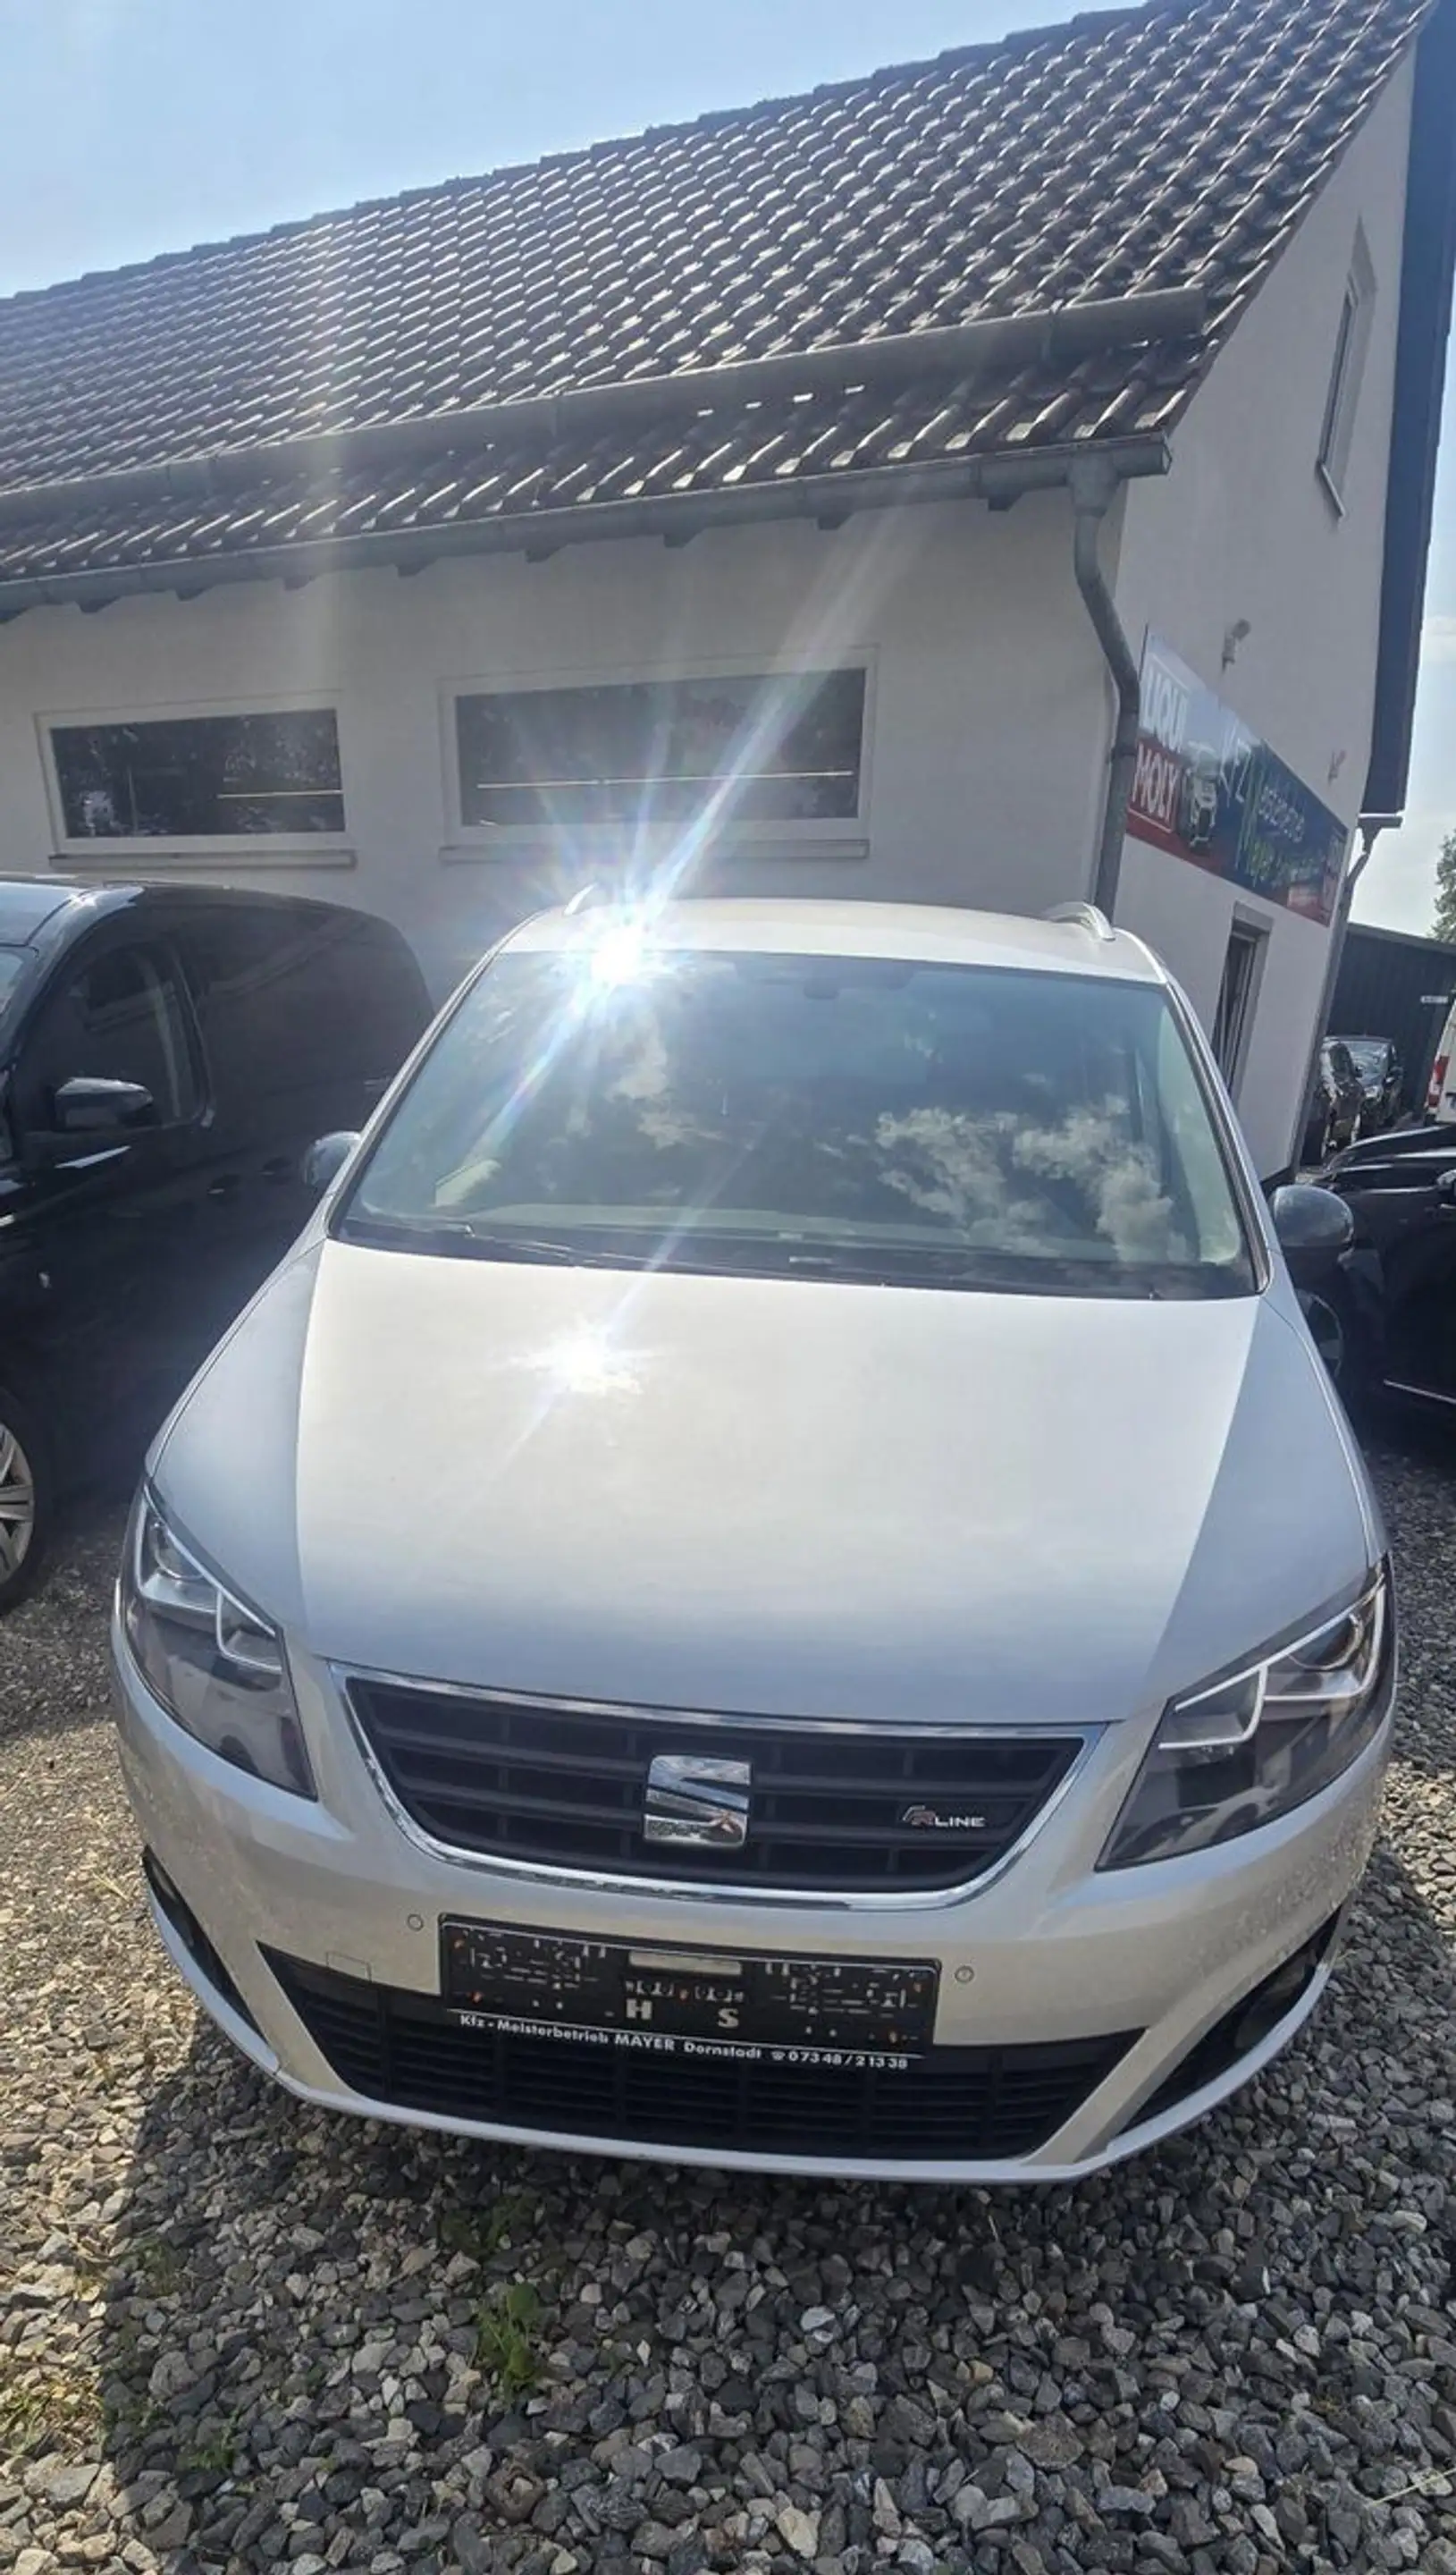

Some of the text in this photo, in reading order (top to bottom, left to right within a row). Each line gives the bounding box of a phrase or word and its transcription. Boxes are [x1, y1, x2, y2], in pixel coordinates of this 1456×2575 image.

[1131, 741, 1181, 823] MOLY
[935, 1816, 985, 1828] LINE
[614, 2035, 674, 2050] MAYER
[684, 2042, 761, 2058] Dornstadt
